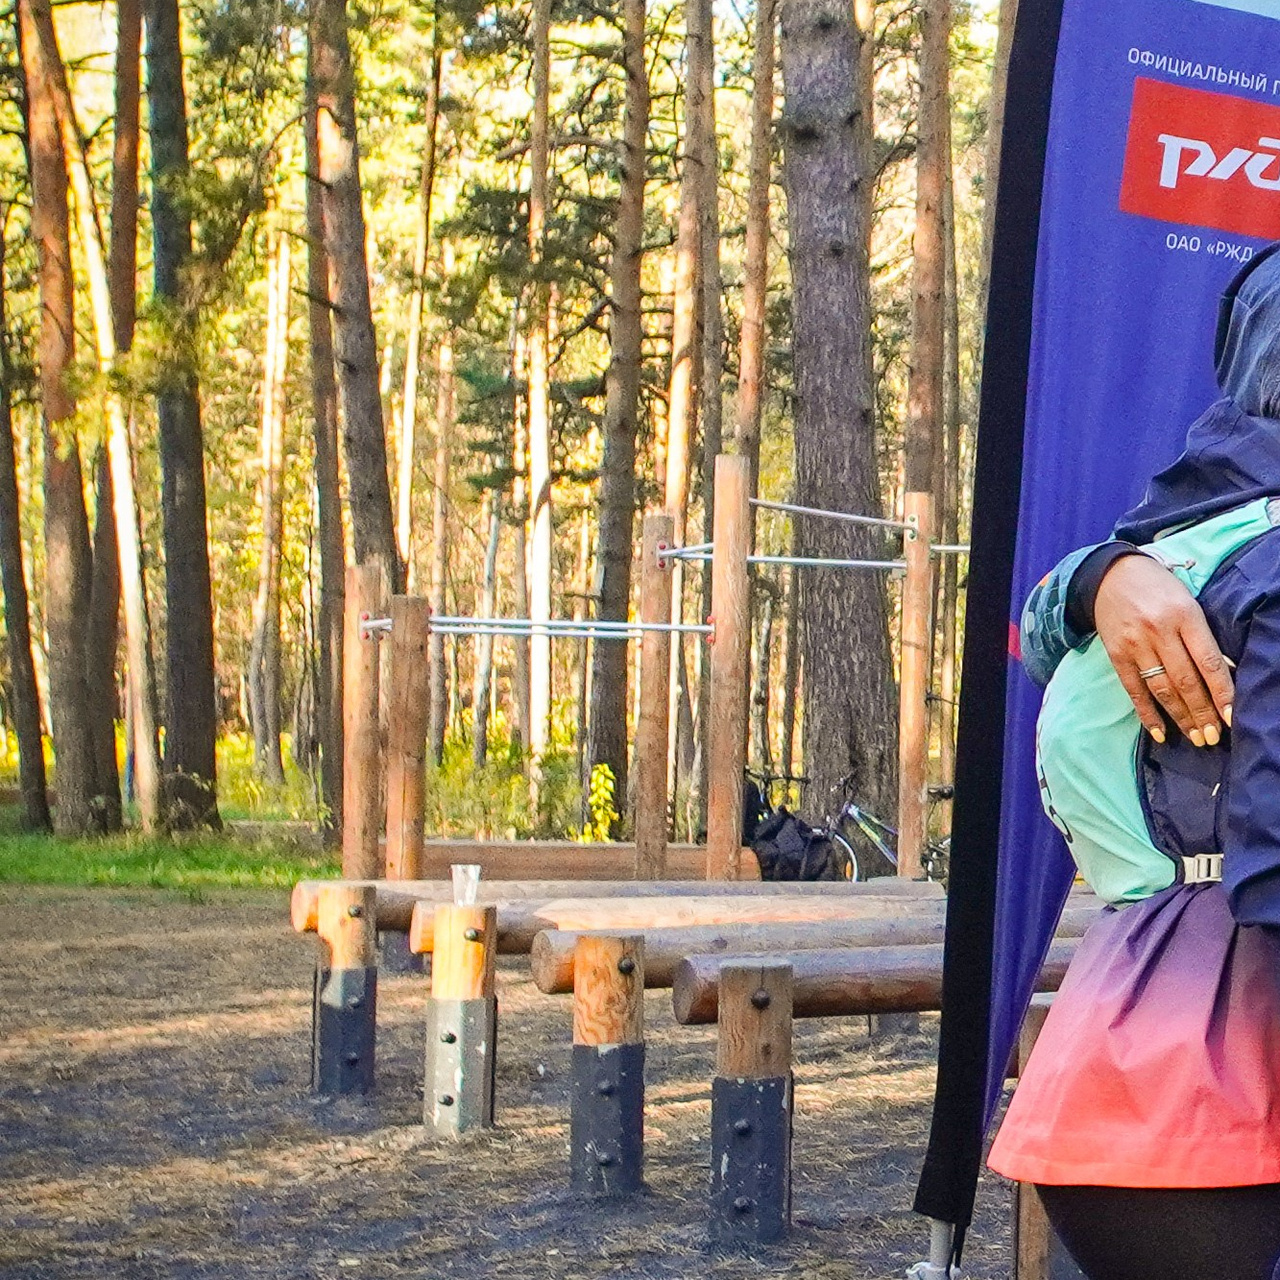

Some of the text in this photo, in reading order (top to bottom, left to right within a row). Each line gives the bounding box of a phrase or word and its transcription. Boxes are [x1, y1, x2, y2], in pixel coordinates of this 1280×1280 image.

[1127, 47, 1267, 93] ОФИЦИАЛЬНЫЙ
[1166, 233, 1257, 263] ОАО «РЖД
